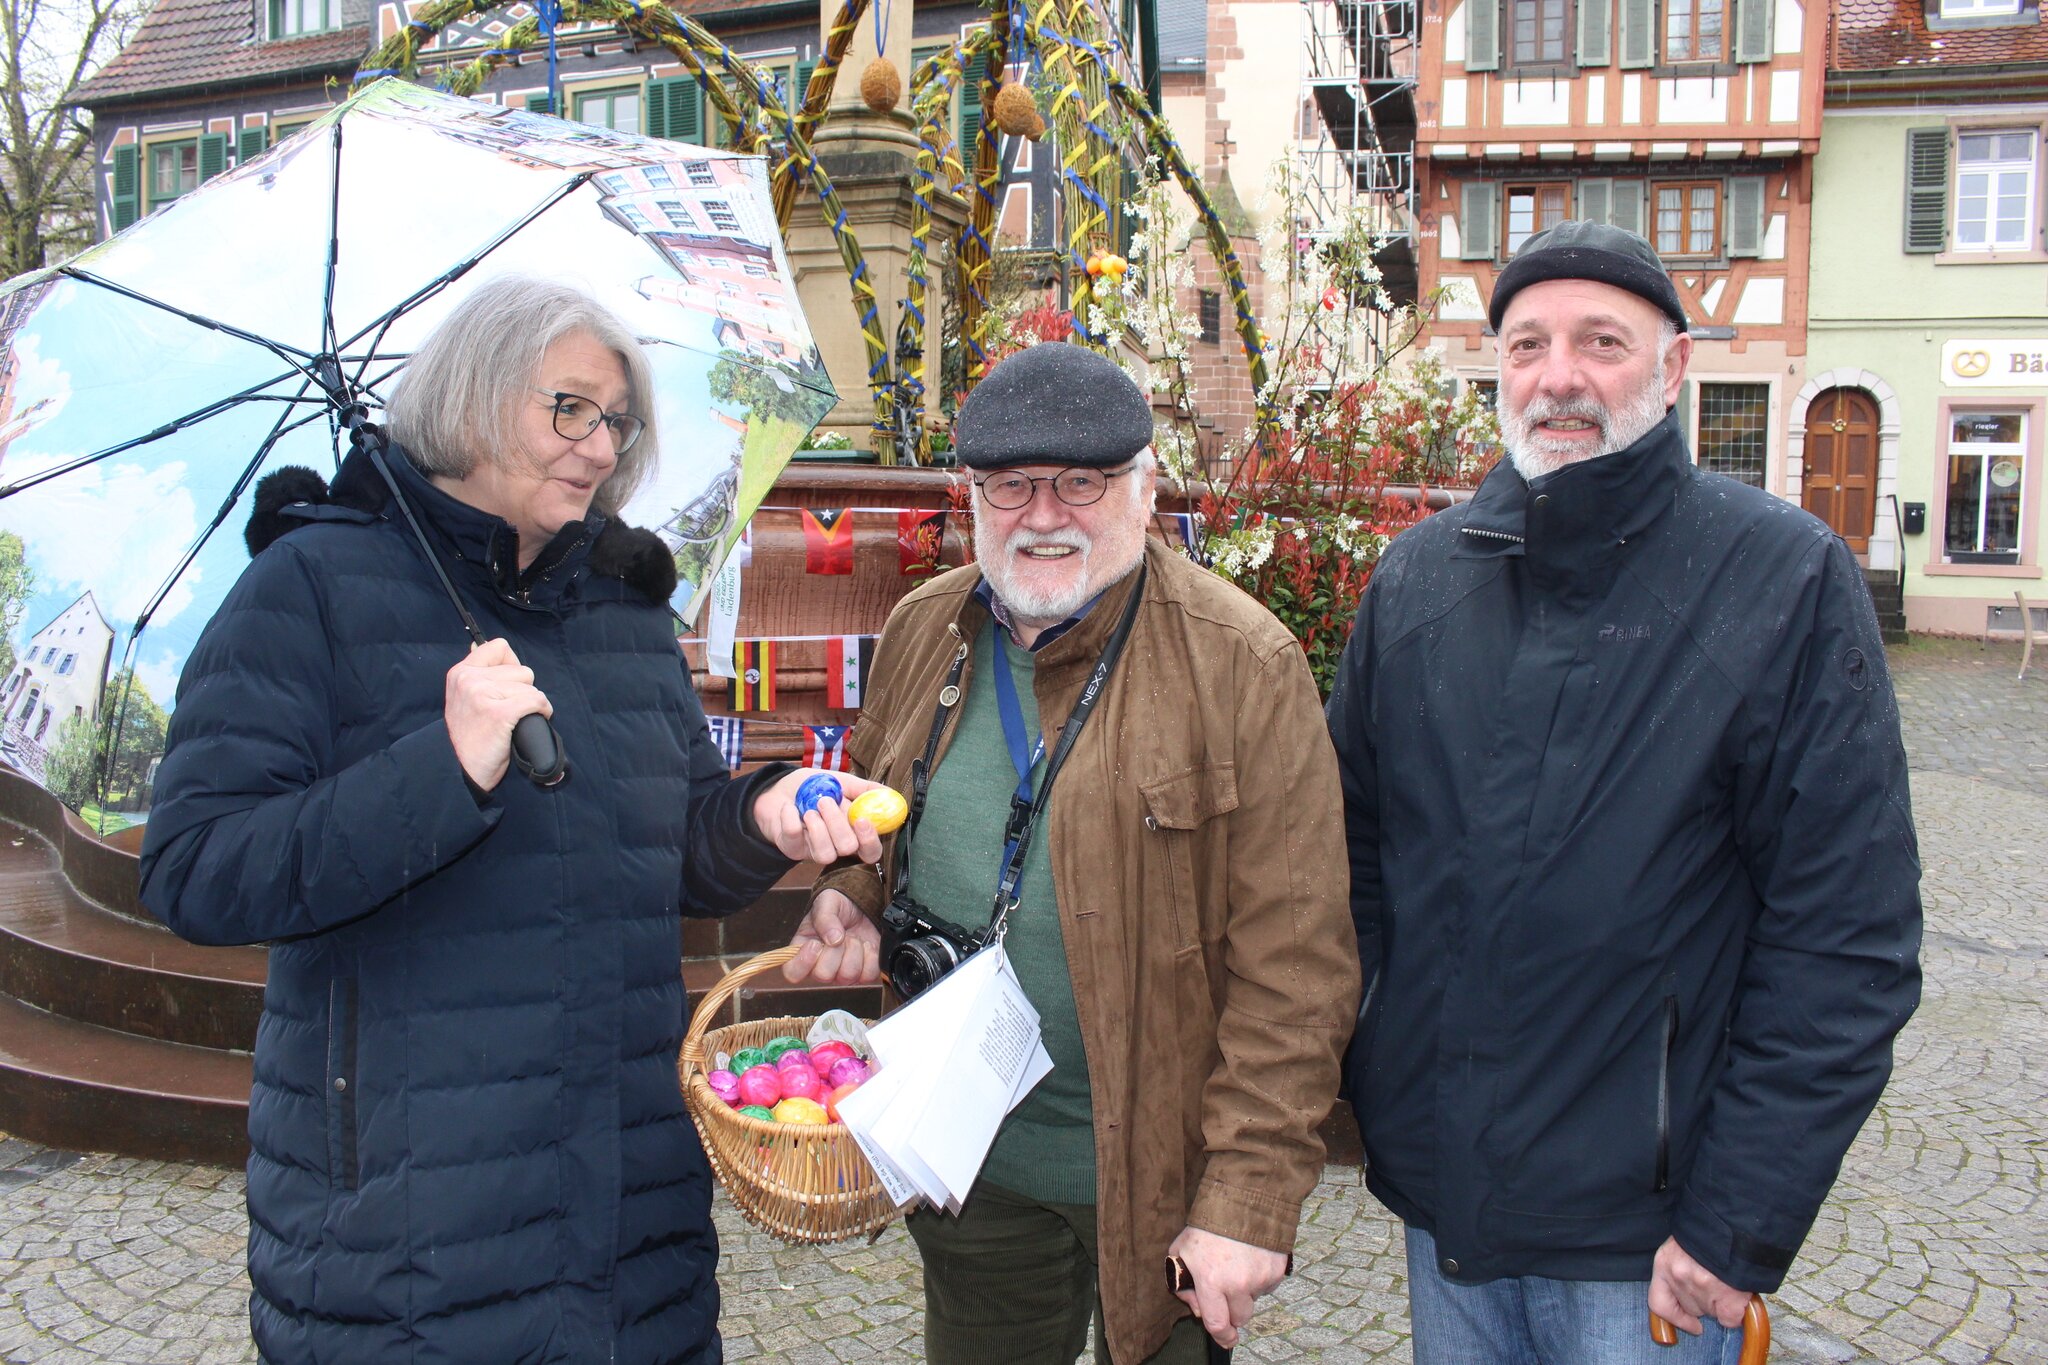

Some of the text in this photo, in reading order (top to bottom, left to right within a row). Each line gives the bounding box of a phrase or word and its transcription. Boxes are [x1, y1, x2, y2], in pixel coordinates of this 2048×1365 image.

[1788, 363, 1795, 375] 6
[2008, 352, 2048, 373] Bä
[724, 565, 737, 617] Ladenburg
[1080, 662, 1107, 706] NEX-7
[917, 919, 932, 931] SONY
